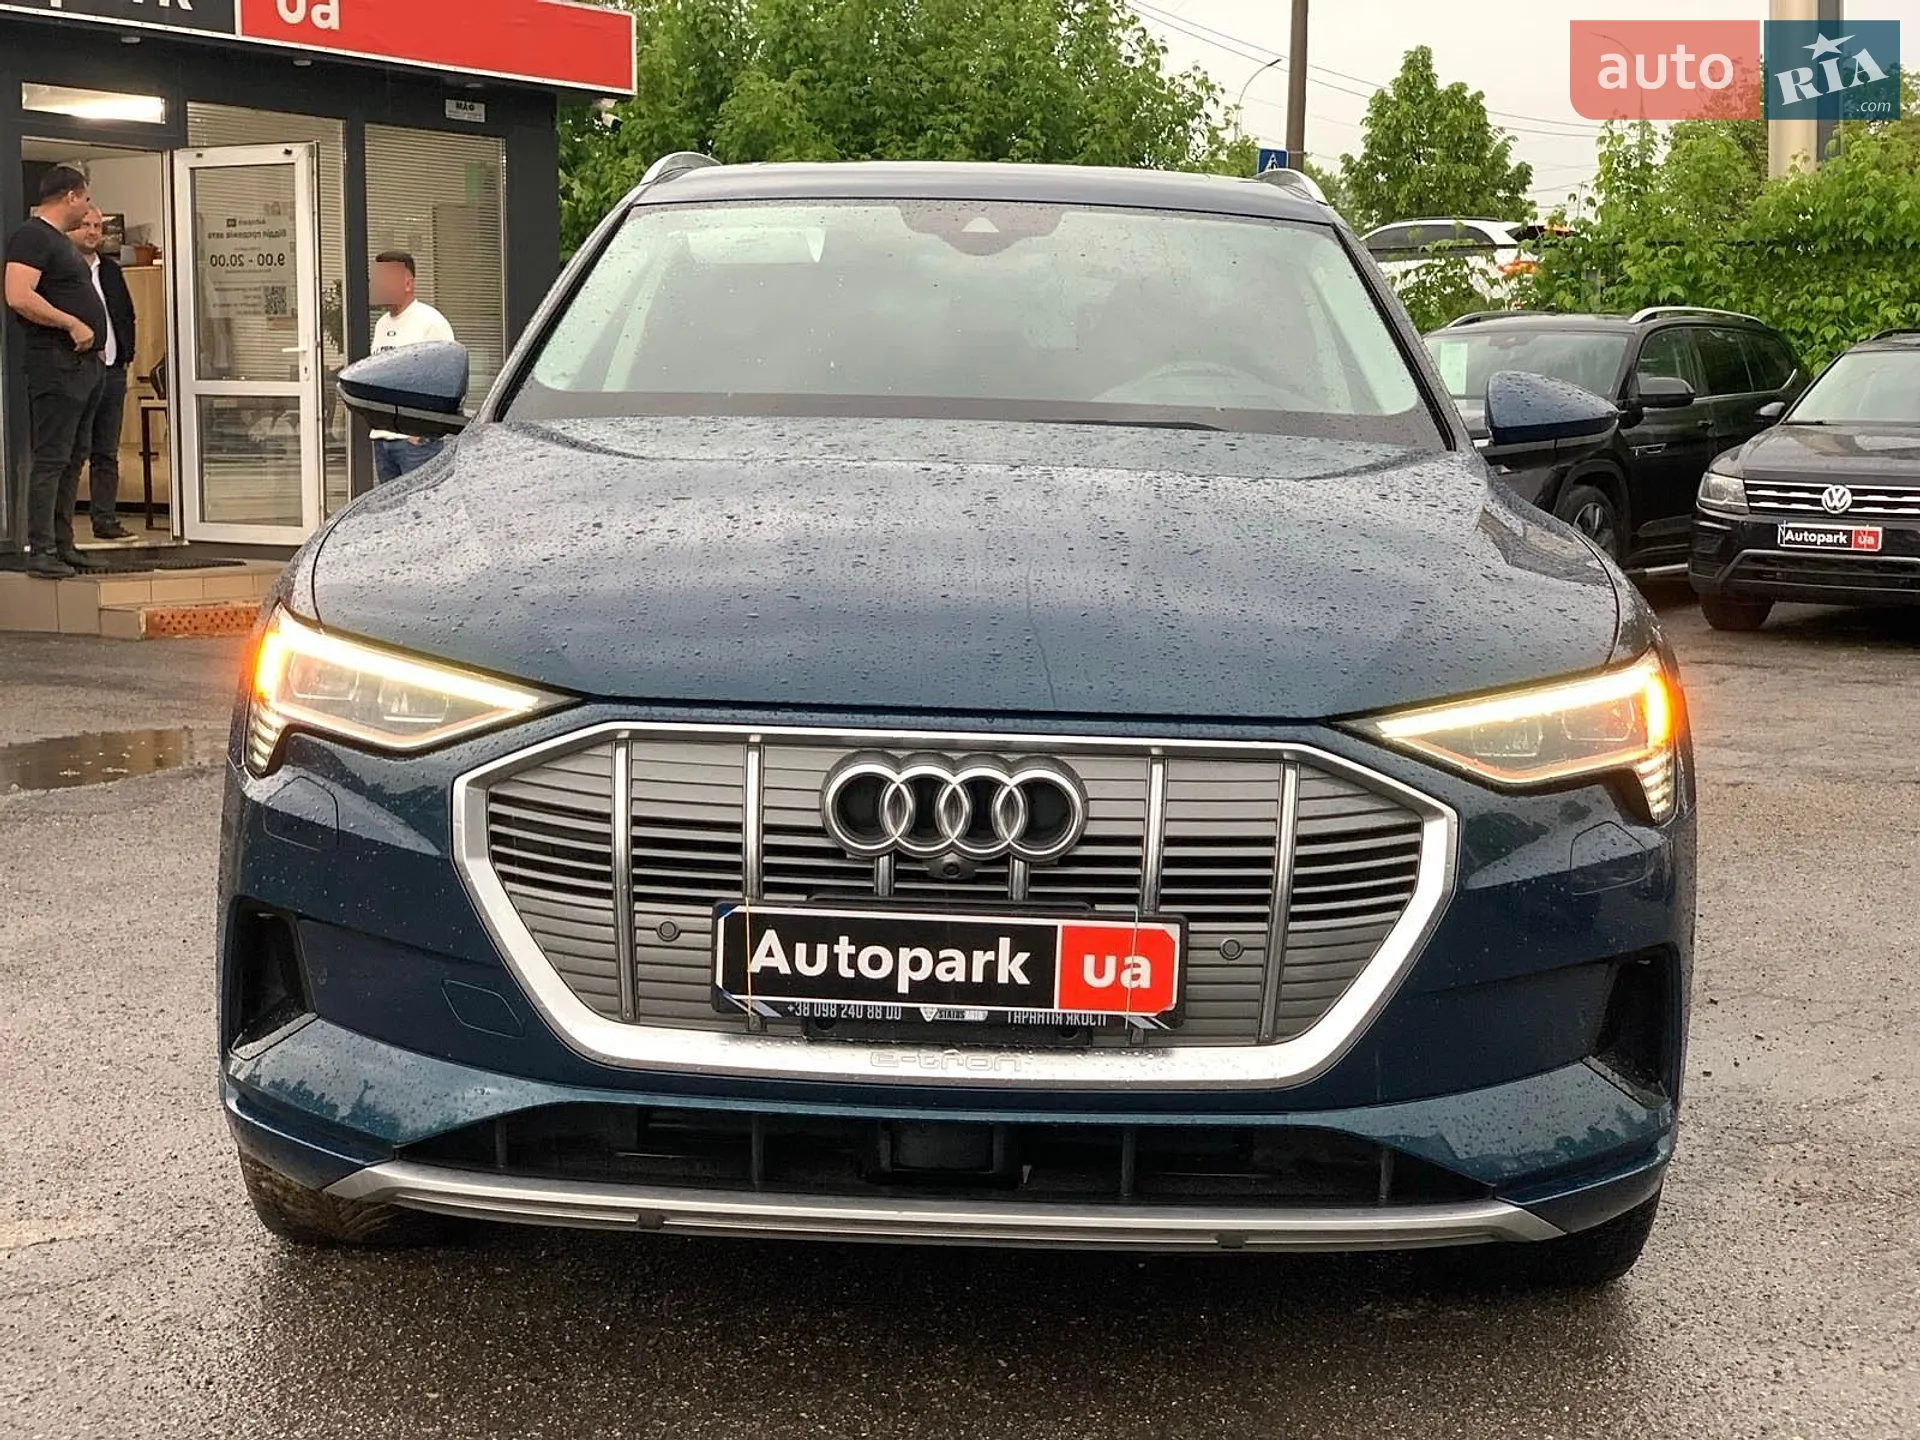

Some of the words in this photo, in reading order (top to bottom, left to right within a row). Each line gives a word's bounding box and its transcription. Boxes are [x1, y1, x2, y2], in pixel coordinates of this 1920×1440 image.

[1784, 529, 1848, 546] Autopark
[747, 928, 1031, 995] Autopark
[1082, 953, 1152, 989] ua
[787, 1001, 810, 1017] +38
[869, 1050, 1022, 1072] e-tron
